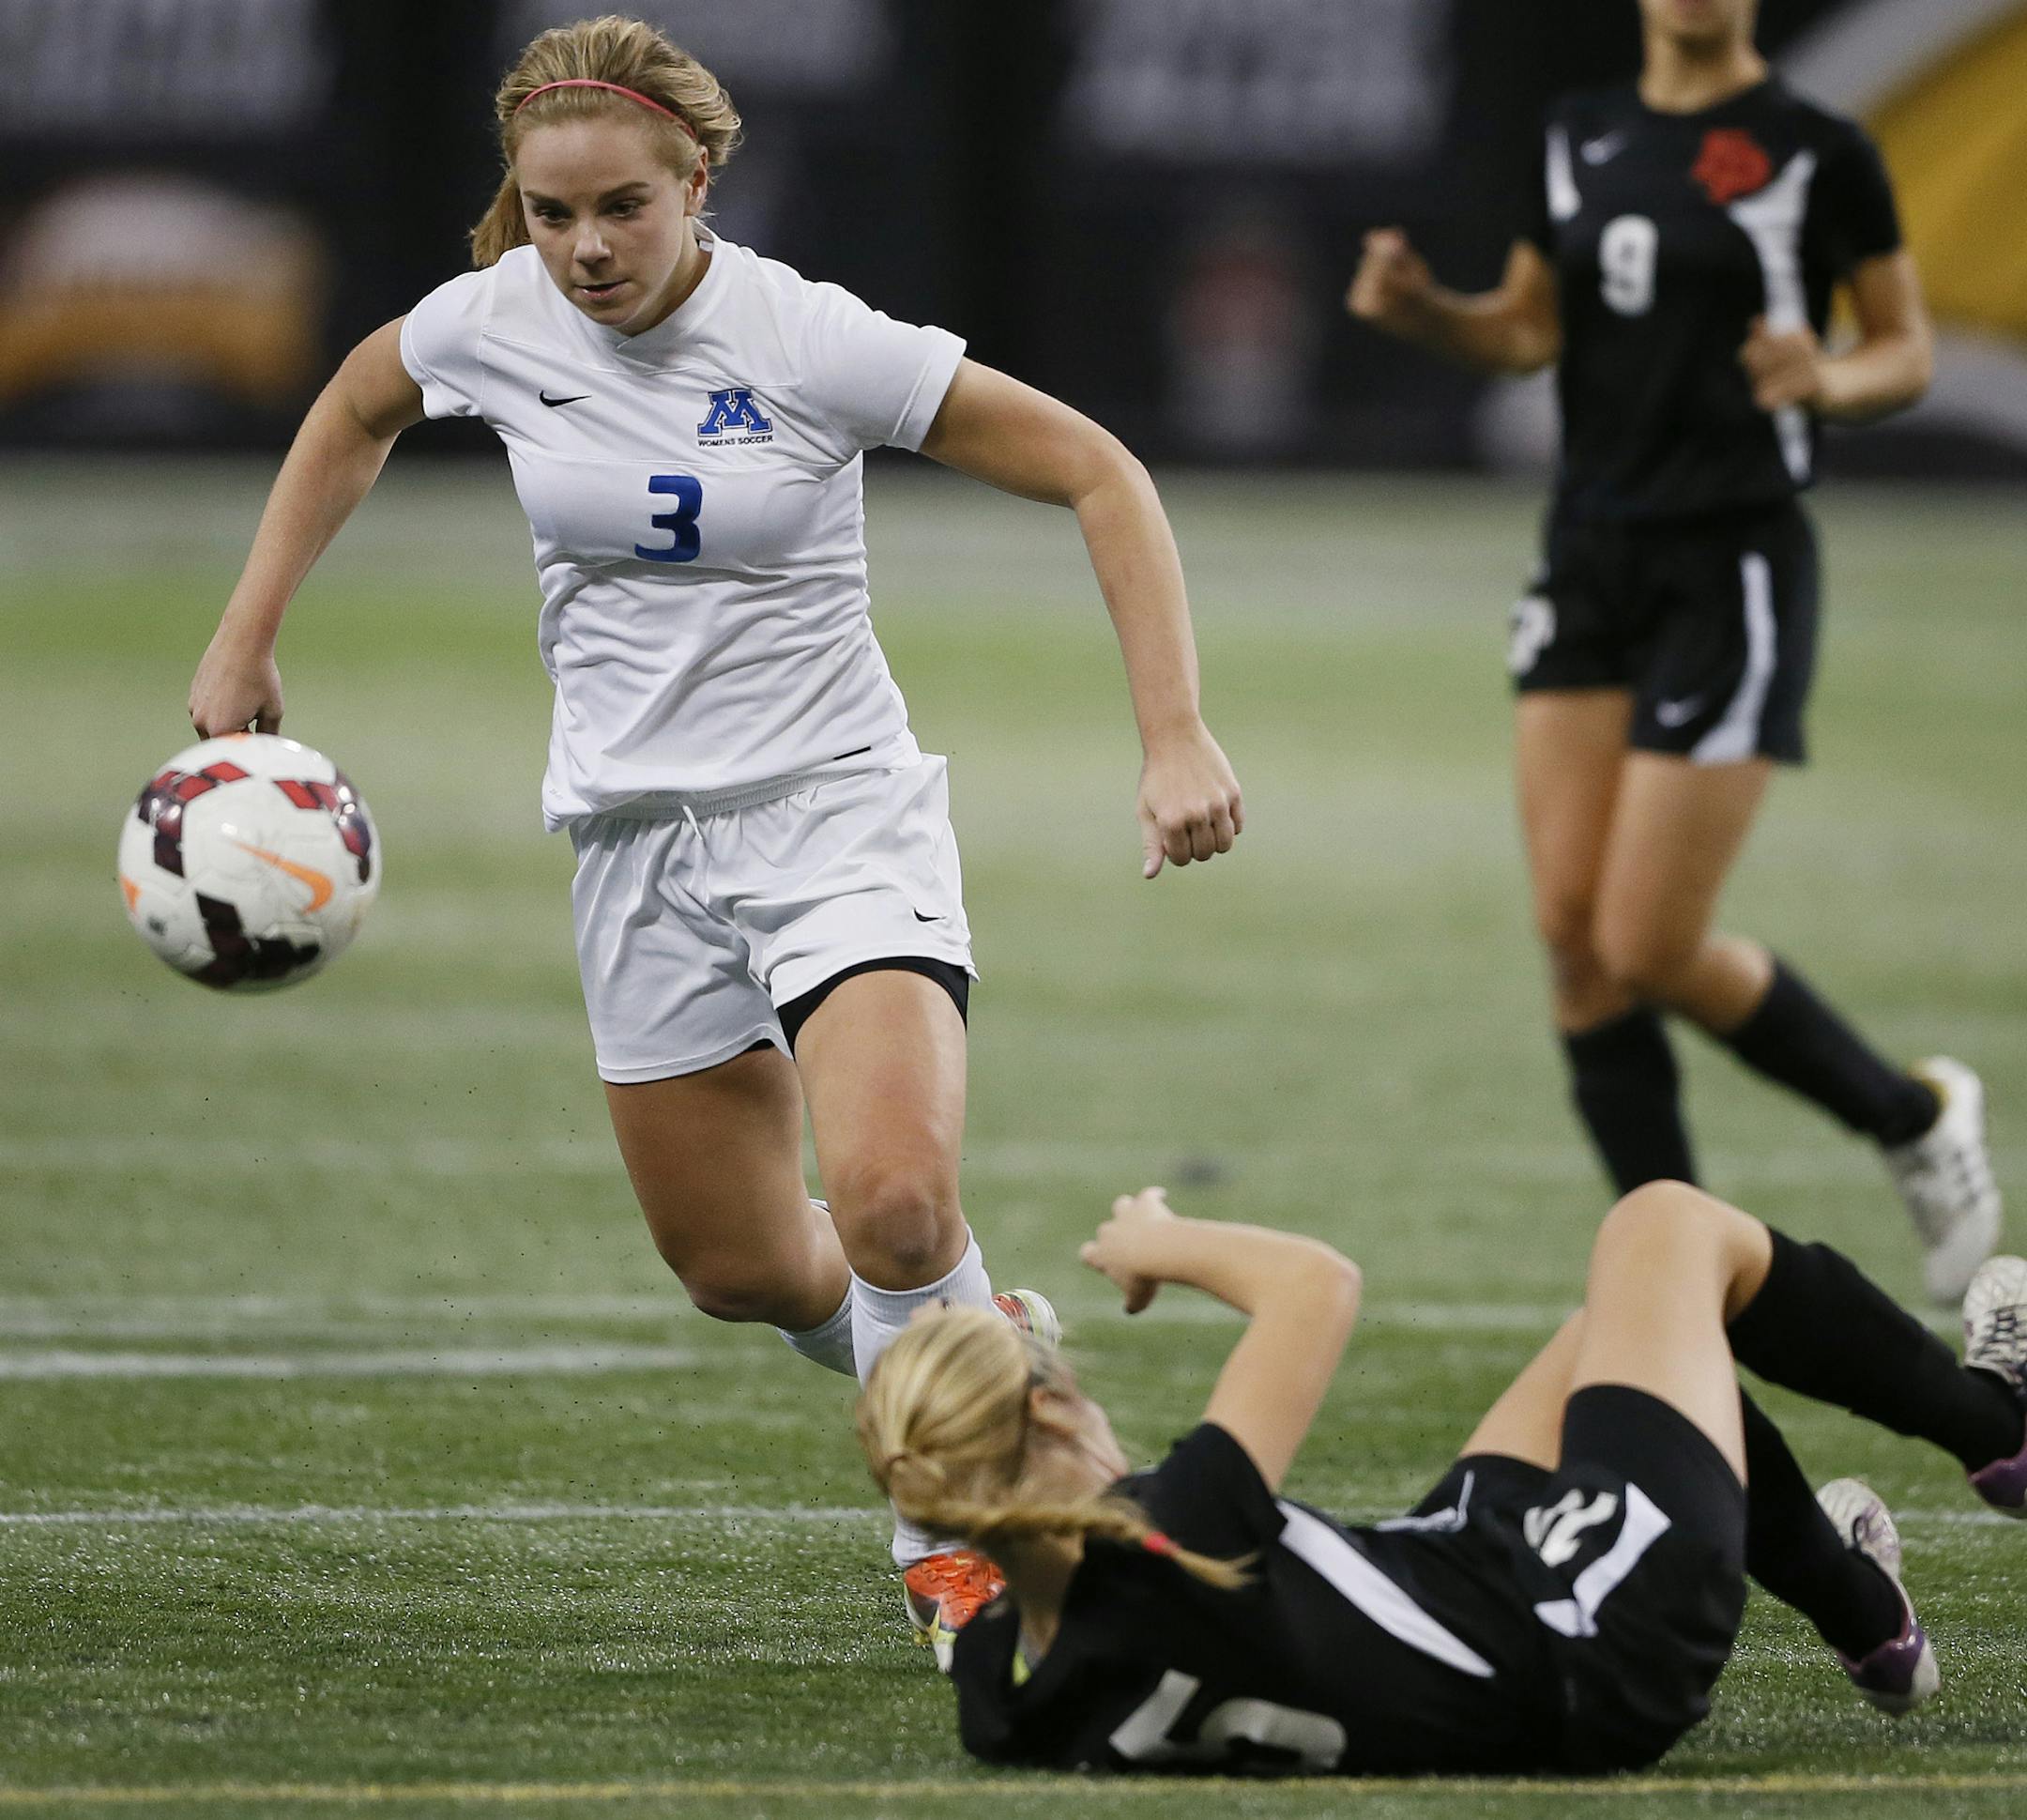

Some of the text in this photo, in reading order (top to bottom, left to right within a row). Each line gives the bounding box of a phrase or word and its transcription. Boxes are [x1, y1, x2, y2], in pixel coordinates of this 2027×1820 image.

[1598, 213, 1659, 317] 9
[697, 388, 773, 436] M
[698, 435, 774, 447] WOMENS SOCCER
[634, 474, 704, 563] 3
